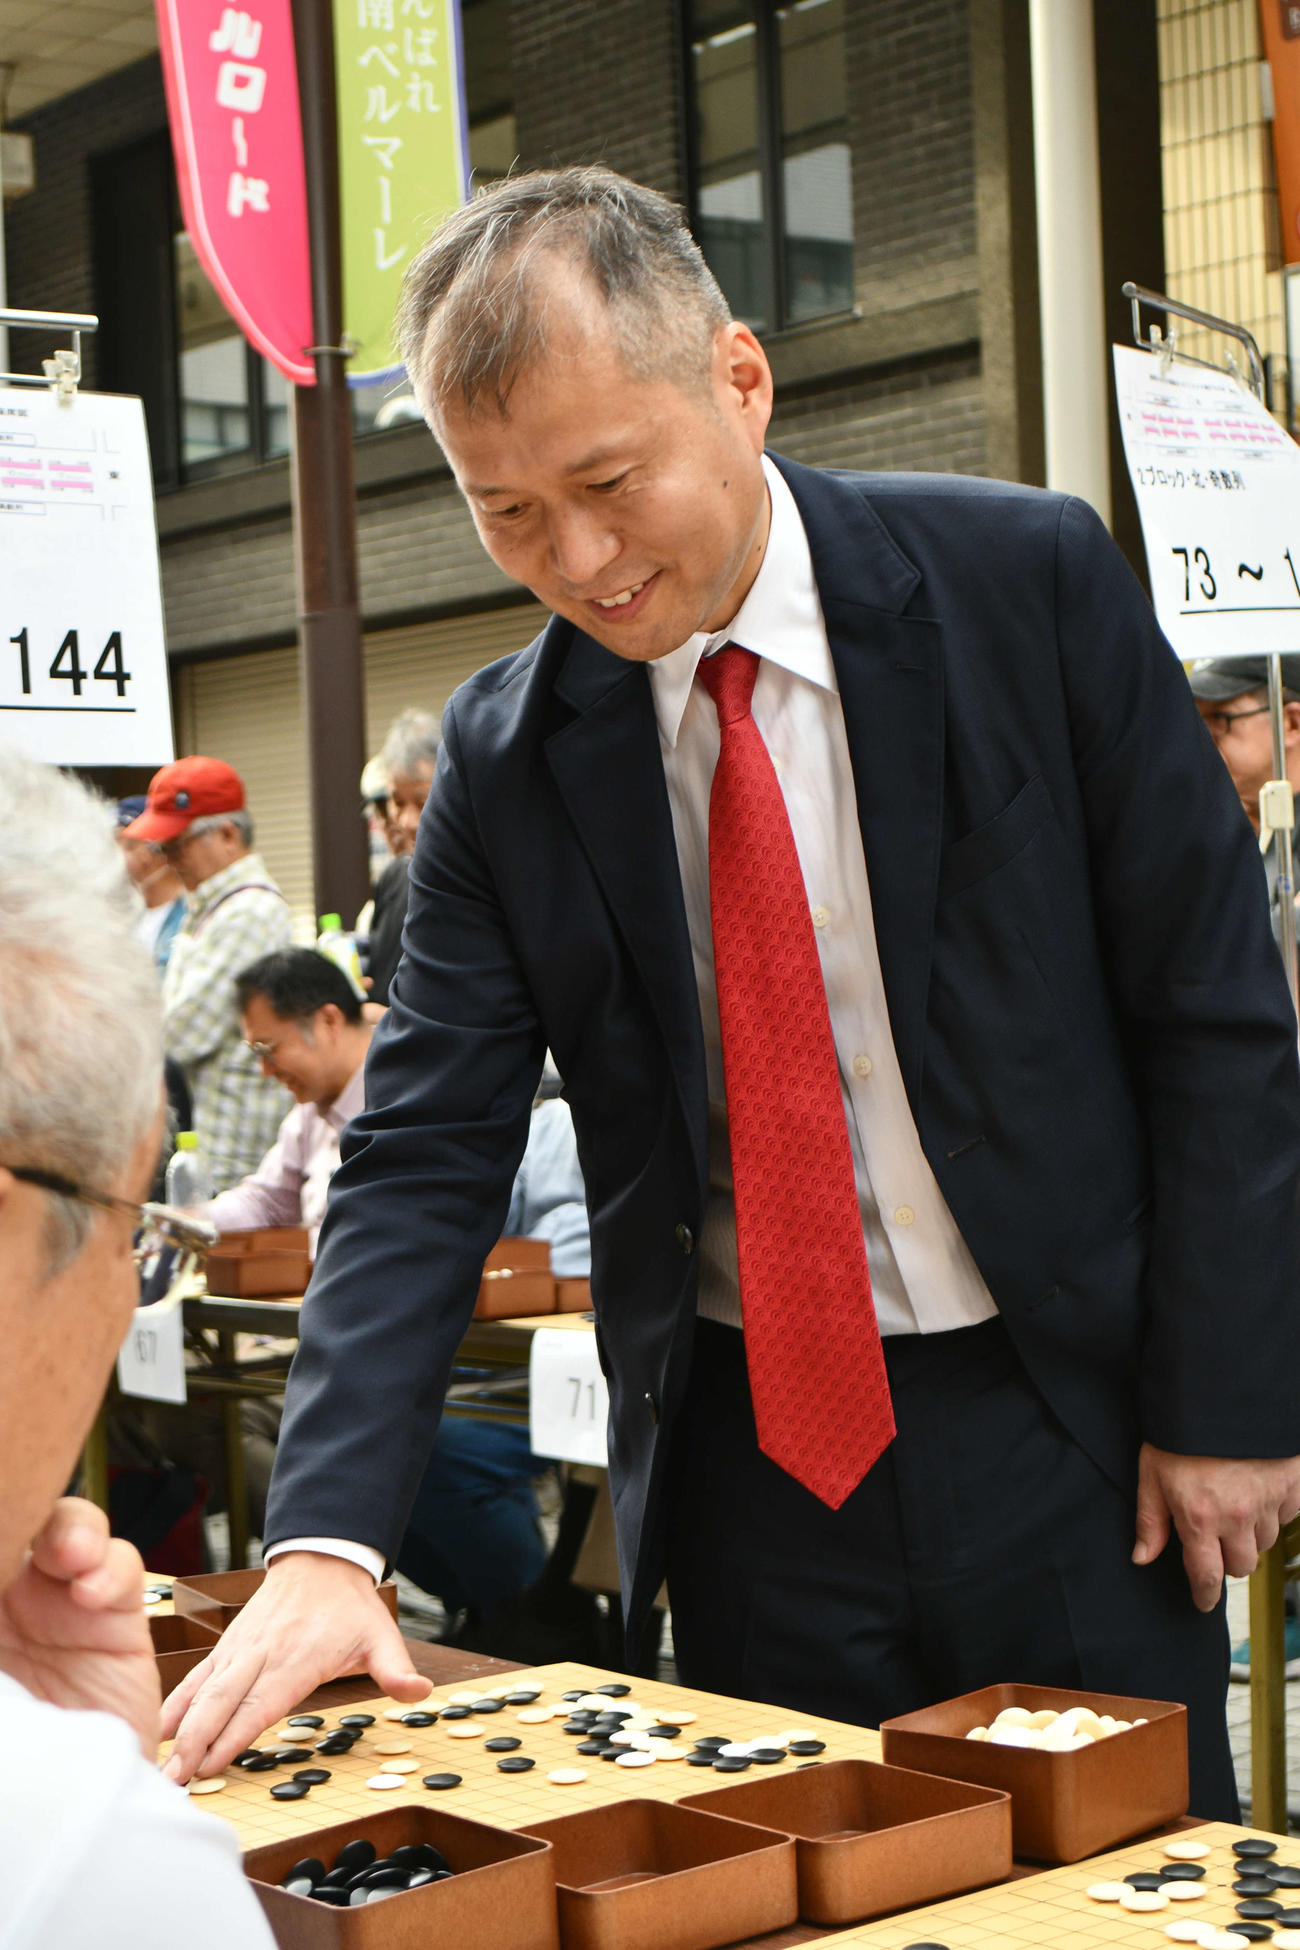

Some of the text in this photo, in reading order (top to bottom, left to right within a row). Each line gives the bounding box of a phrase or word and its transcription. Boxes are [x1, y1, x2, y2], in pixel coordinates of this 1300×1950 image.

[209, 0, 270, 218] ルロード
[1172, 547, 1217, 601] 73
[10, 626, 132, 697] 144
[568, 1377, 597, 1421] 71
